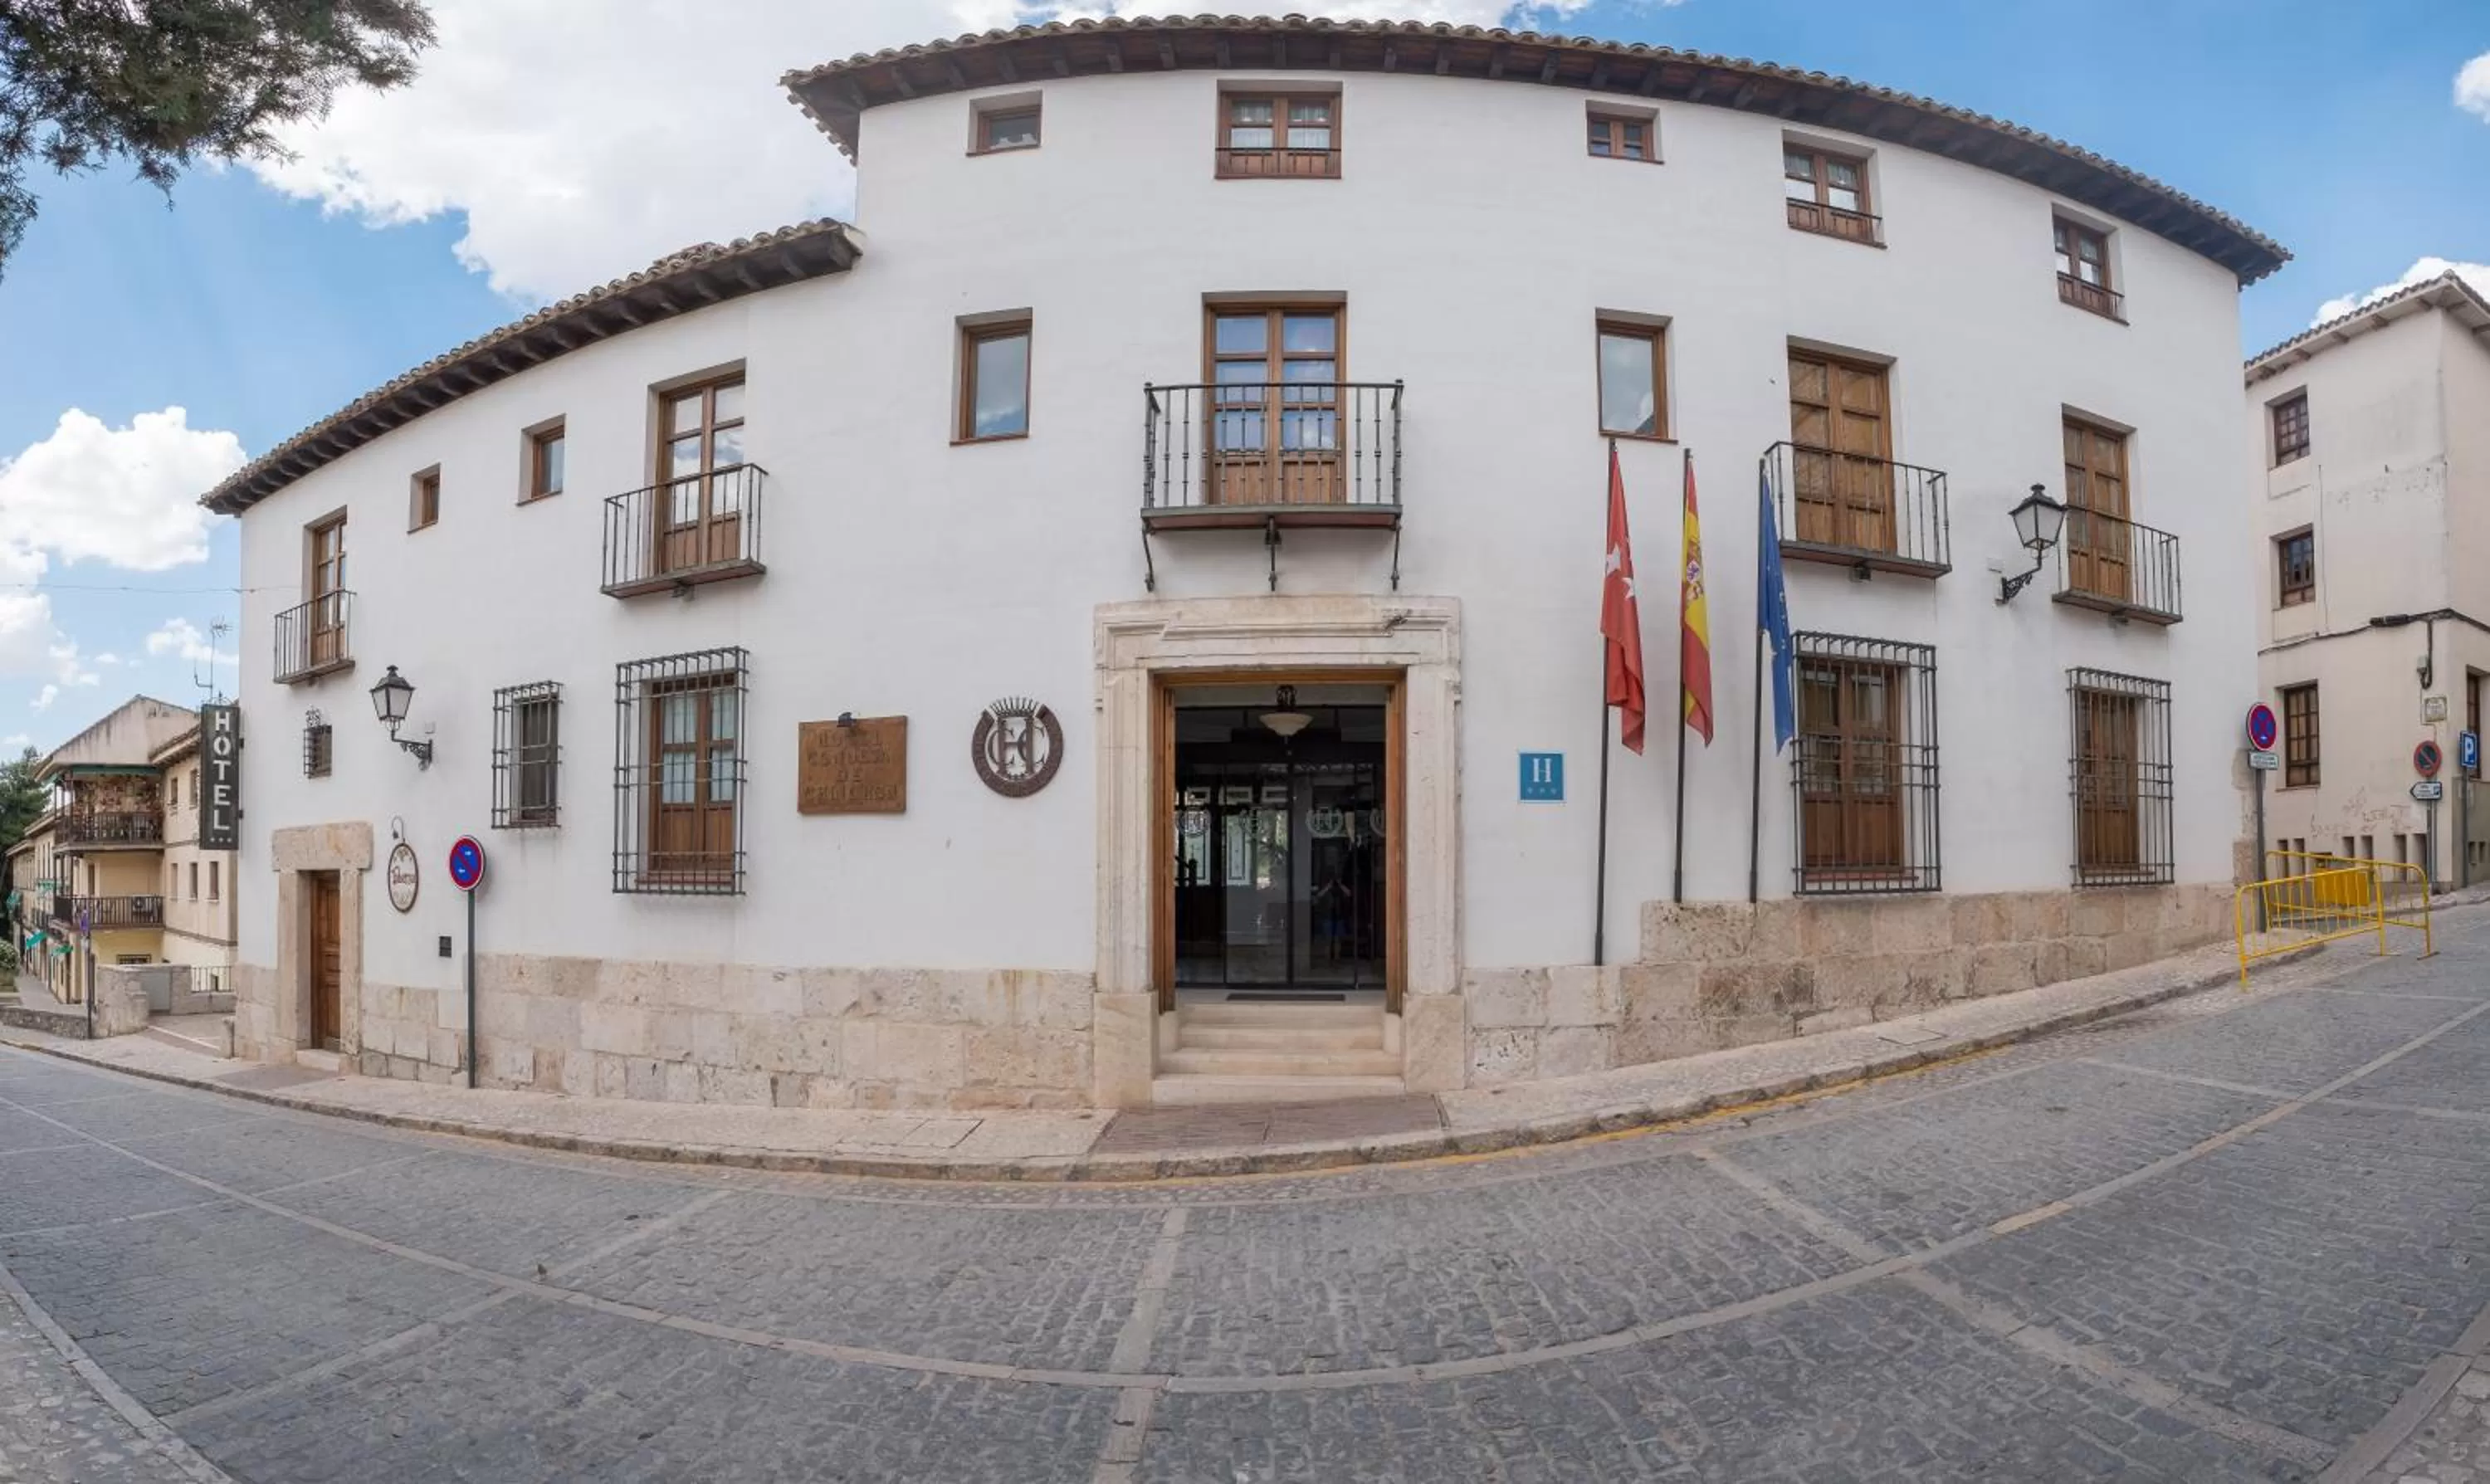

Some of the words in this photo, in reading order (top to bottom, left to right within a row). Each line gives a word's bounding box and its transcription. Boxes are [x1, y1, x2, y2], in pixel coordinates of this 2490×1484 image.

[818, 728, 882, 748] HOL
[2464, 736, 2474, 762] P
[212, 710, 232, 831] HOTEL
[1532, 758, 1552, 783] H
